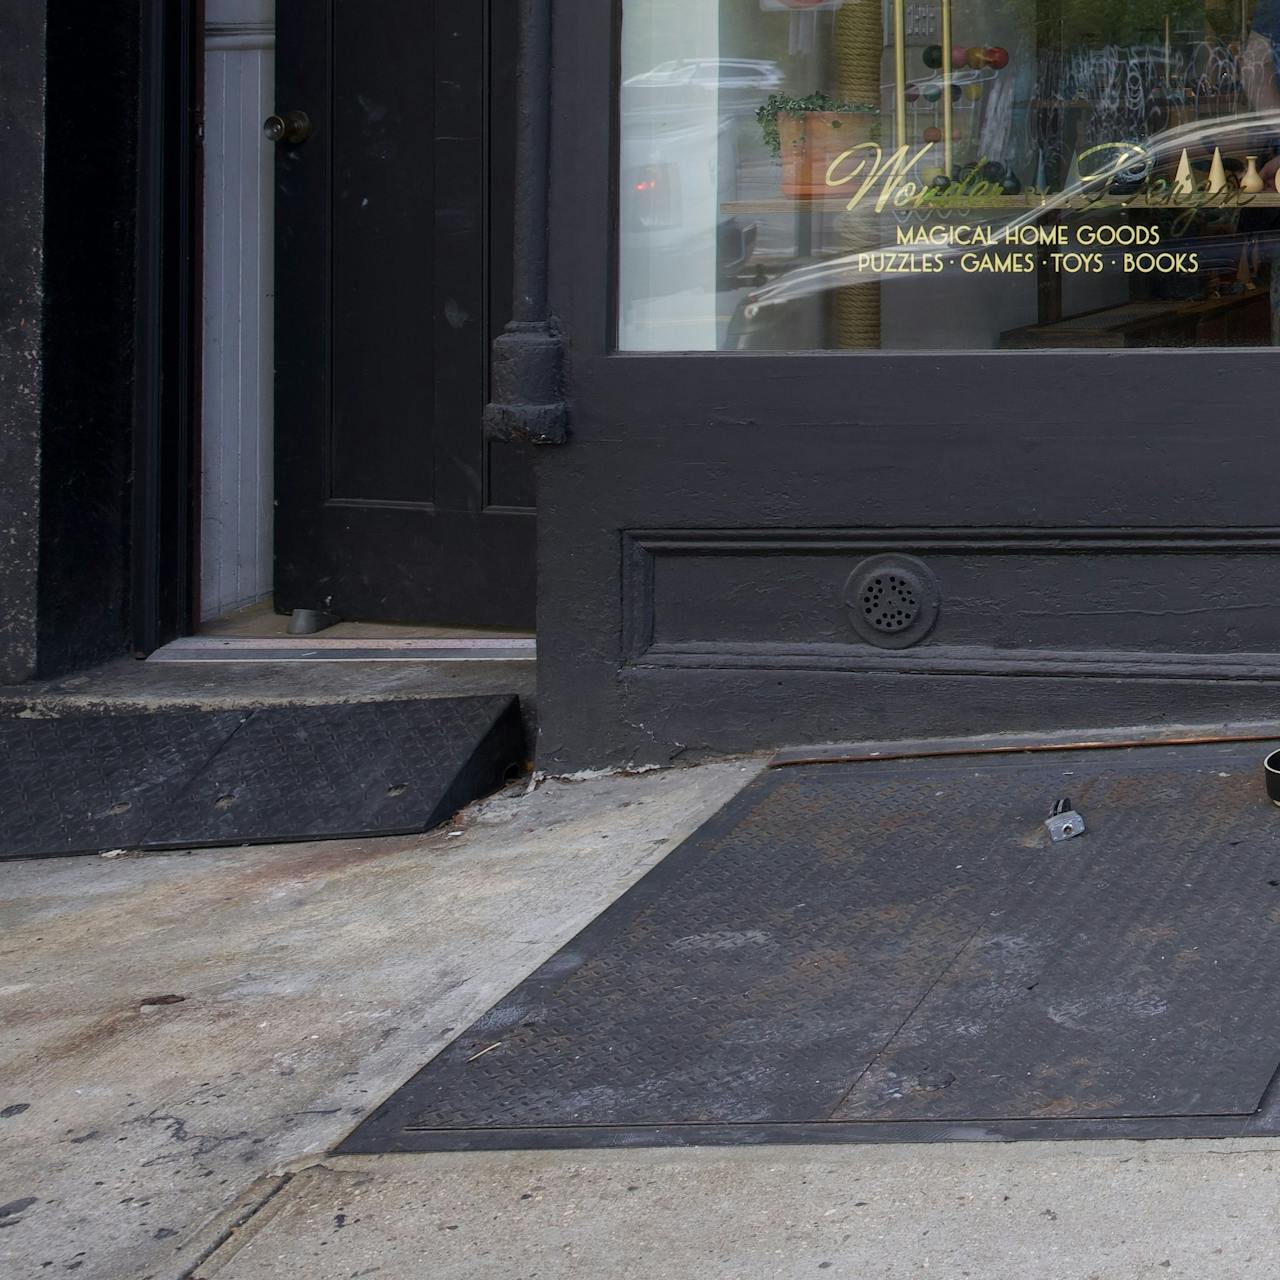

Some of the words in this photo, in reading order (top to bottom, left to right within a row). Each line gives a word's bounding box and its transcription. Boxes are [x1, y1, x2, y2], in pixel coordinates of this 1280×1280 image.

[824, 141, 1005, 214] Wonder
[896, 225, 999, 246] MAGICAL
[1004, 225, 1069, 246] HOME
[1076, 224, 1161, 246] GOODS
[857, 252, 944, 273] PUZZLES
[960, 252, 1035, 274] GAMES
[1051, 252, 1104, 274] TOYS
[1123, 252, 1199, 274] BOOKS
